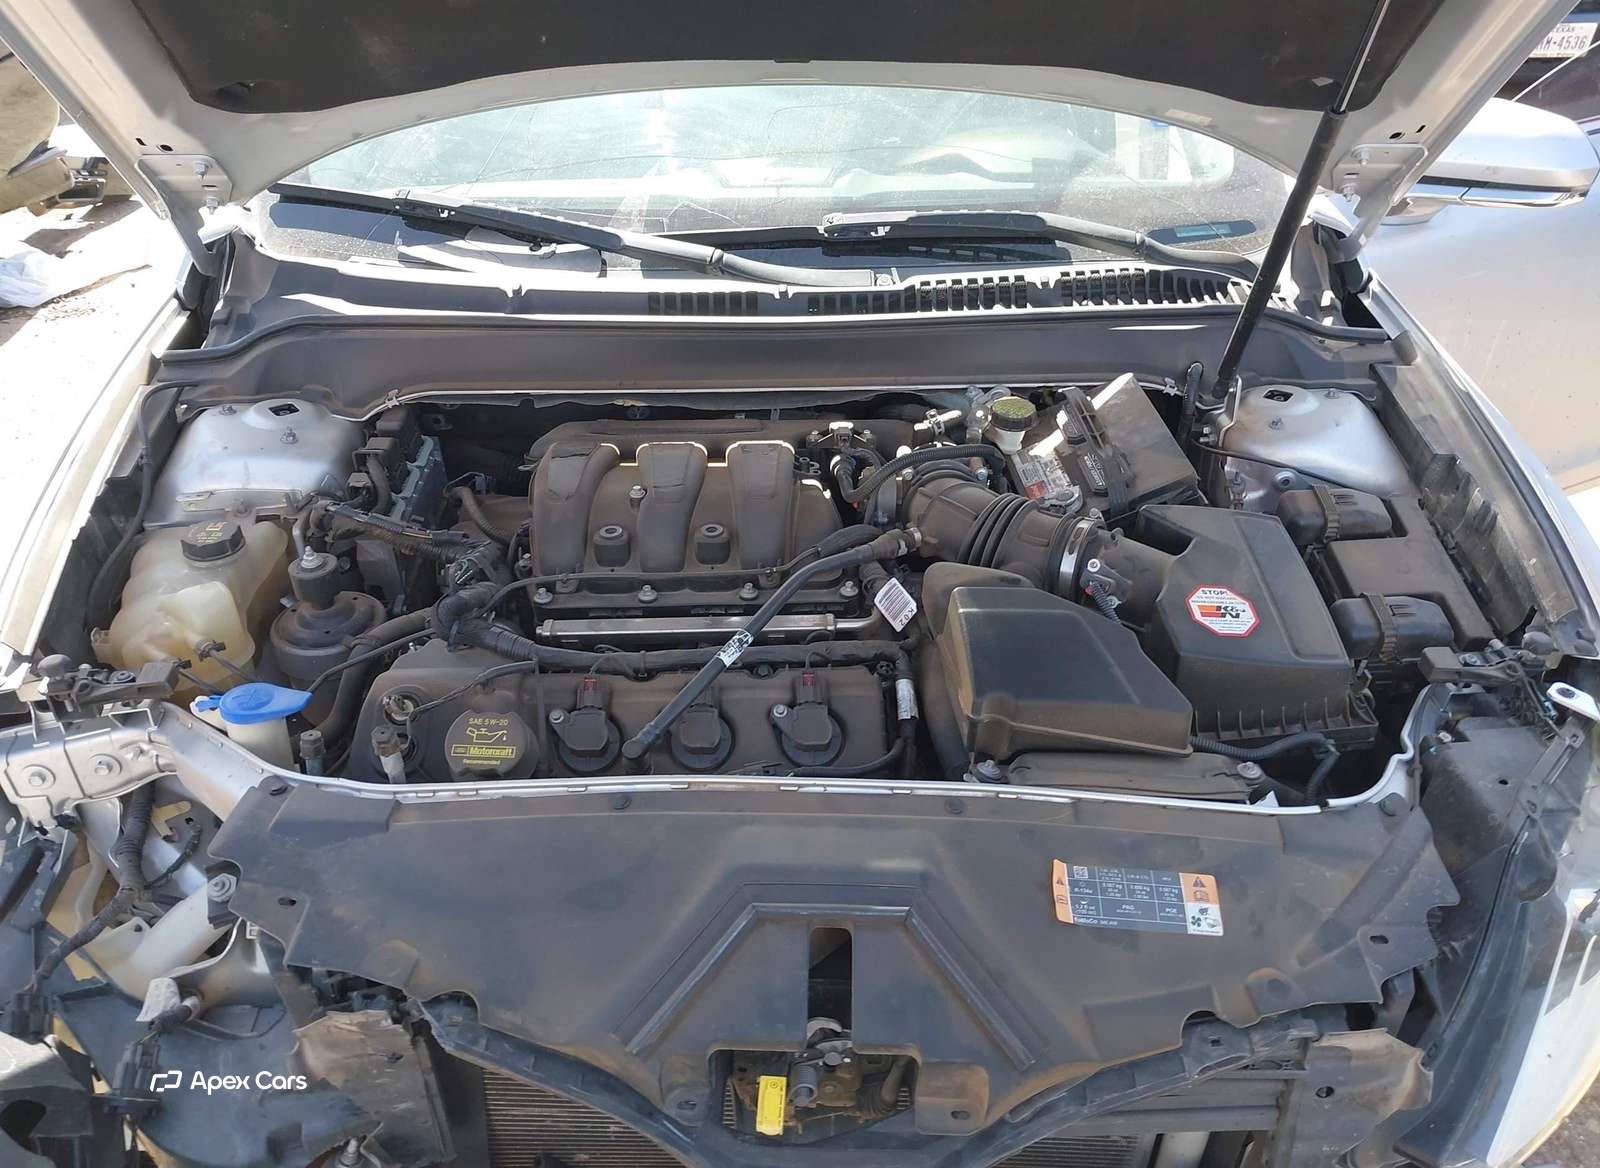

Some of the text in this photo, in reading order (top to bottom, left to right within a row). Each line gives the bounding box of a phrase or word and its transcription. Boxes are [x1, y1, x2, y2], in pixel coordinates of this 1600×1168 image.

[468, 717, 483, 725] SAE
[469, 746, 513, 756] Motorcraft
[462, 758, 501, 766] Recommended
